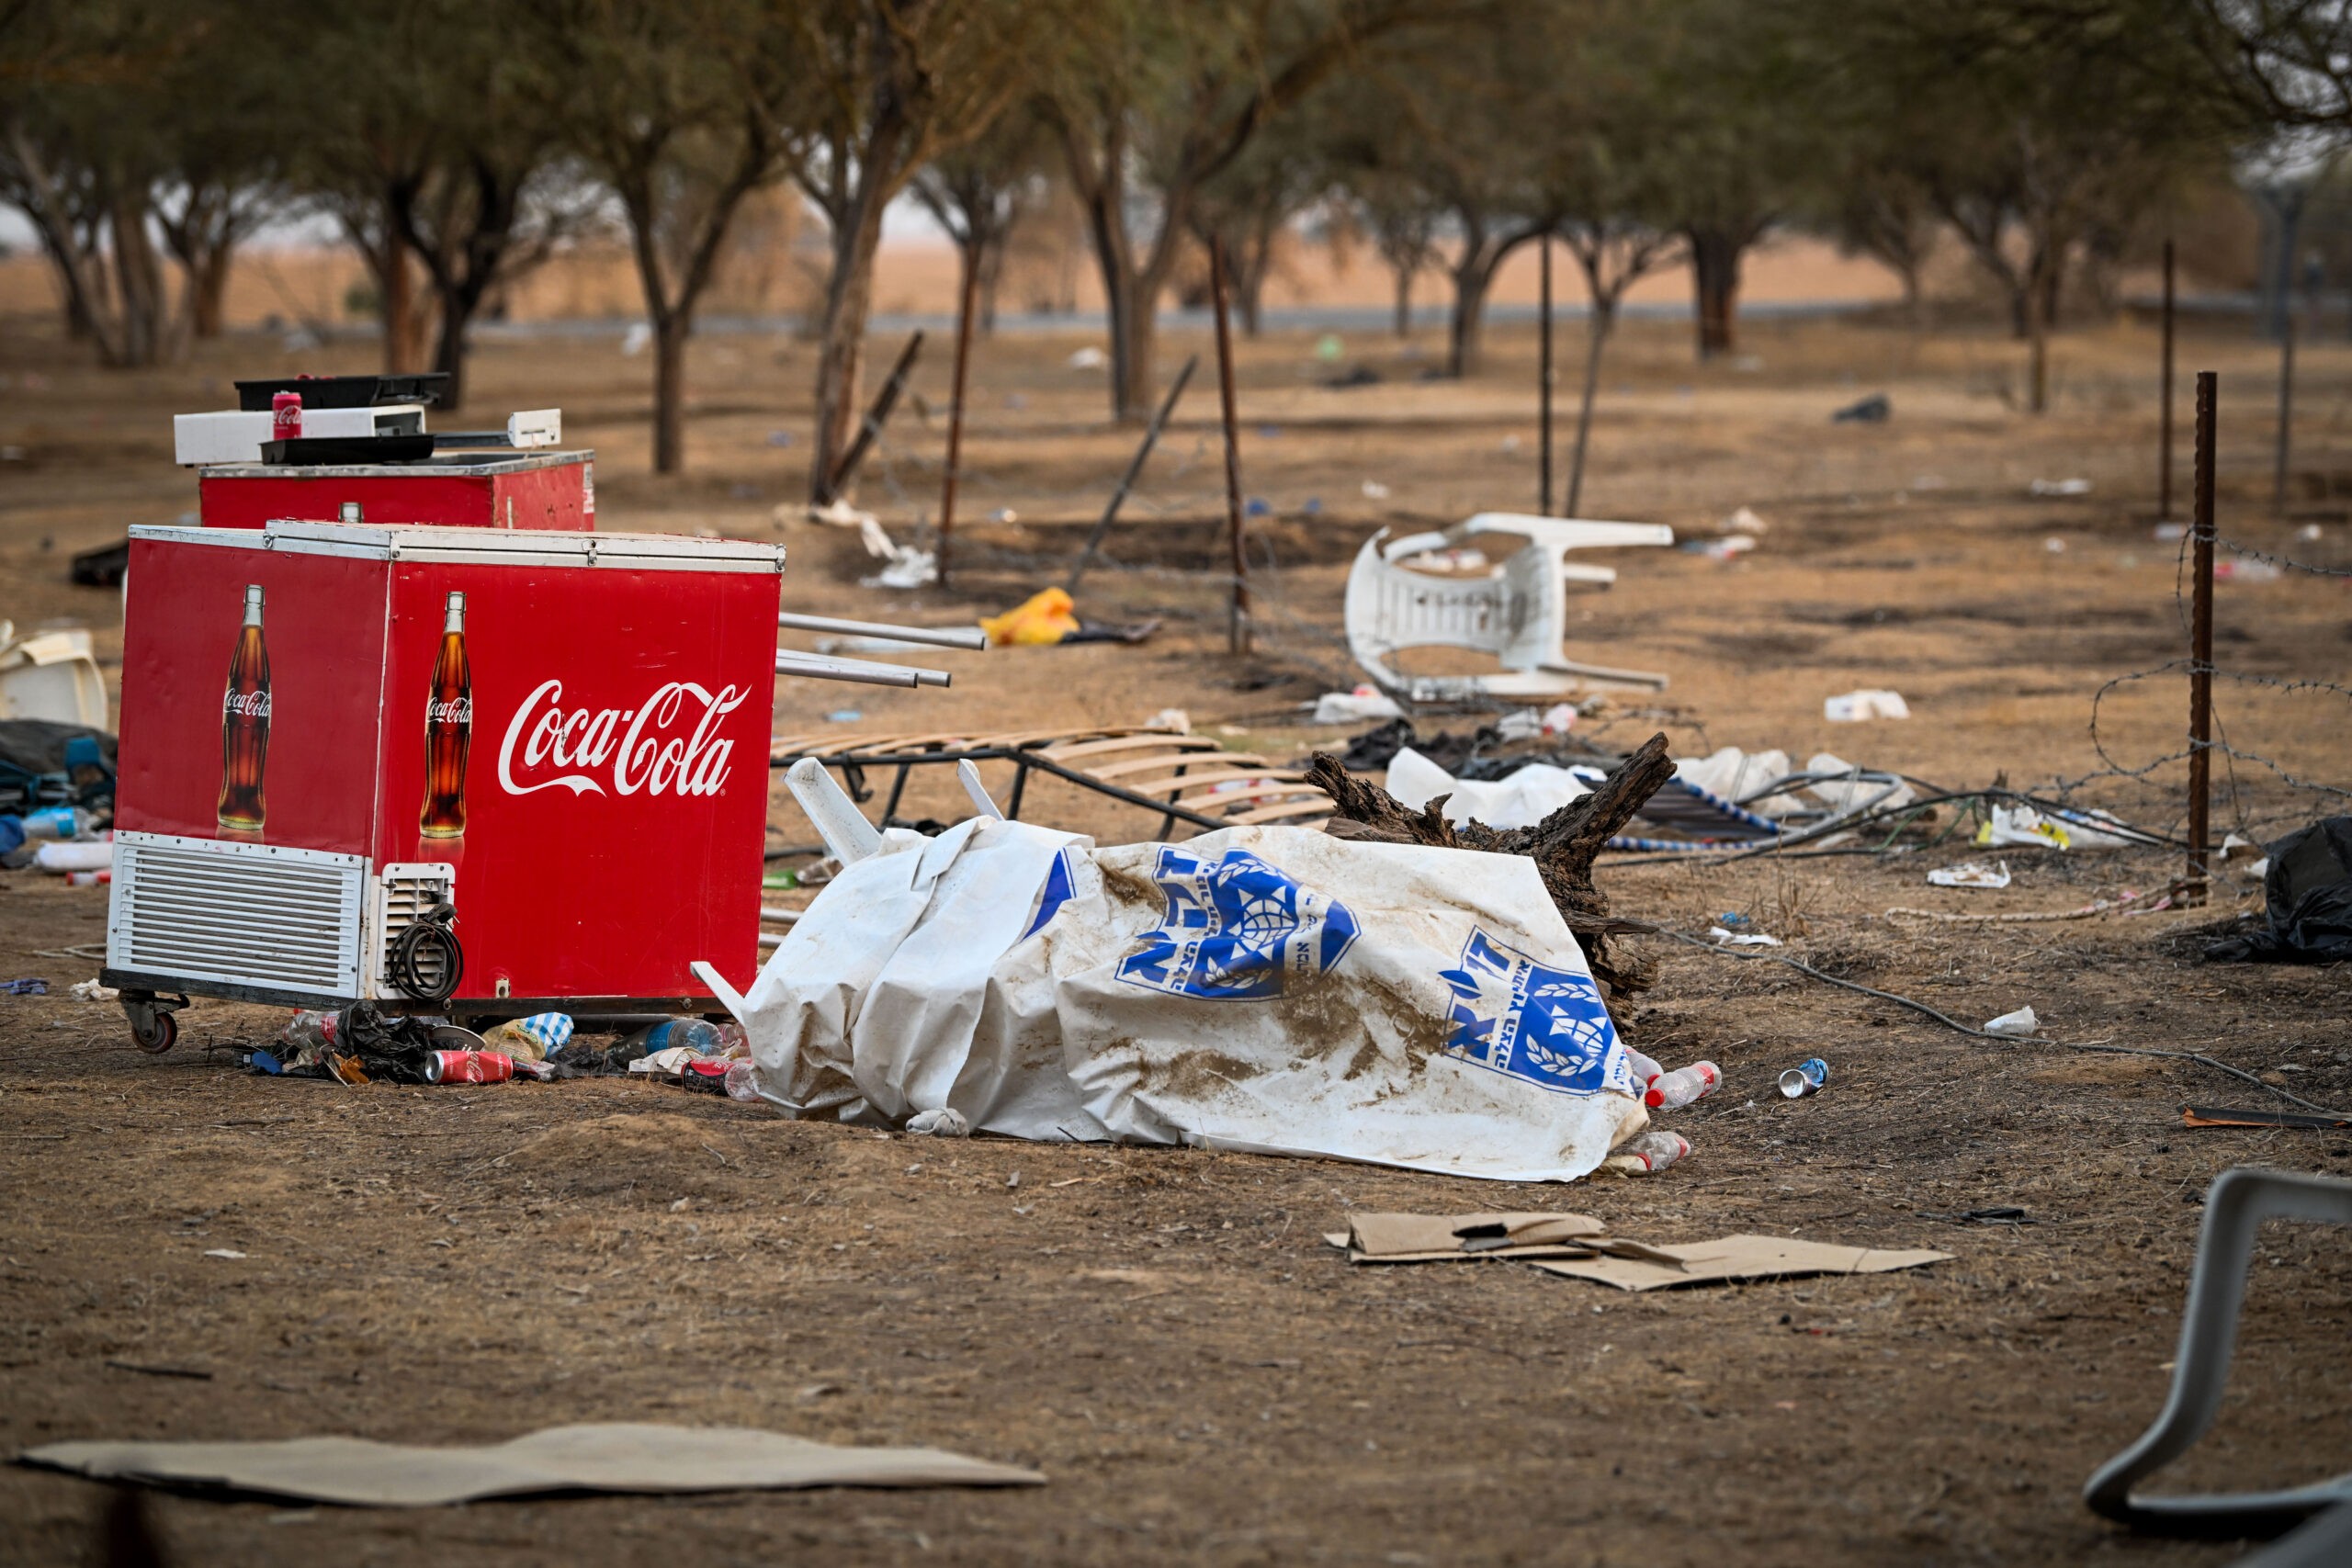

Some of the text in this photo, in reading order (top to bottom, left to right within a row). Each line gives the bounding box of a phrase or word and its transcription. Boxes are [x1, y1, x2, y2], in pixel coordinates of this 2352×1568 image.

[223, 687, 272, 717] Coca-Cola
[425, 696, 472, 723] Coca-Cola
[497, 679, 752, 797] Coca-Cola
[1170, 941, 1198, 990] הצלה
[1494, 1018, 1517, 1069] הצלה
